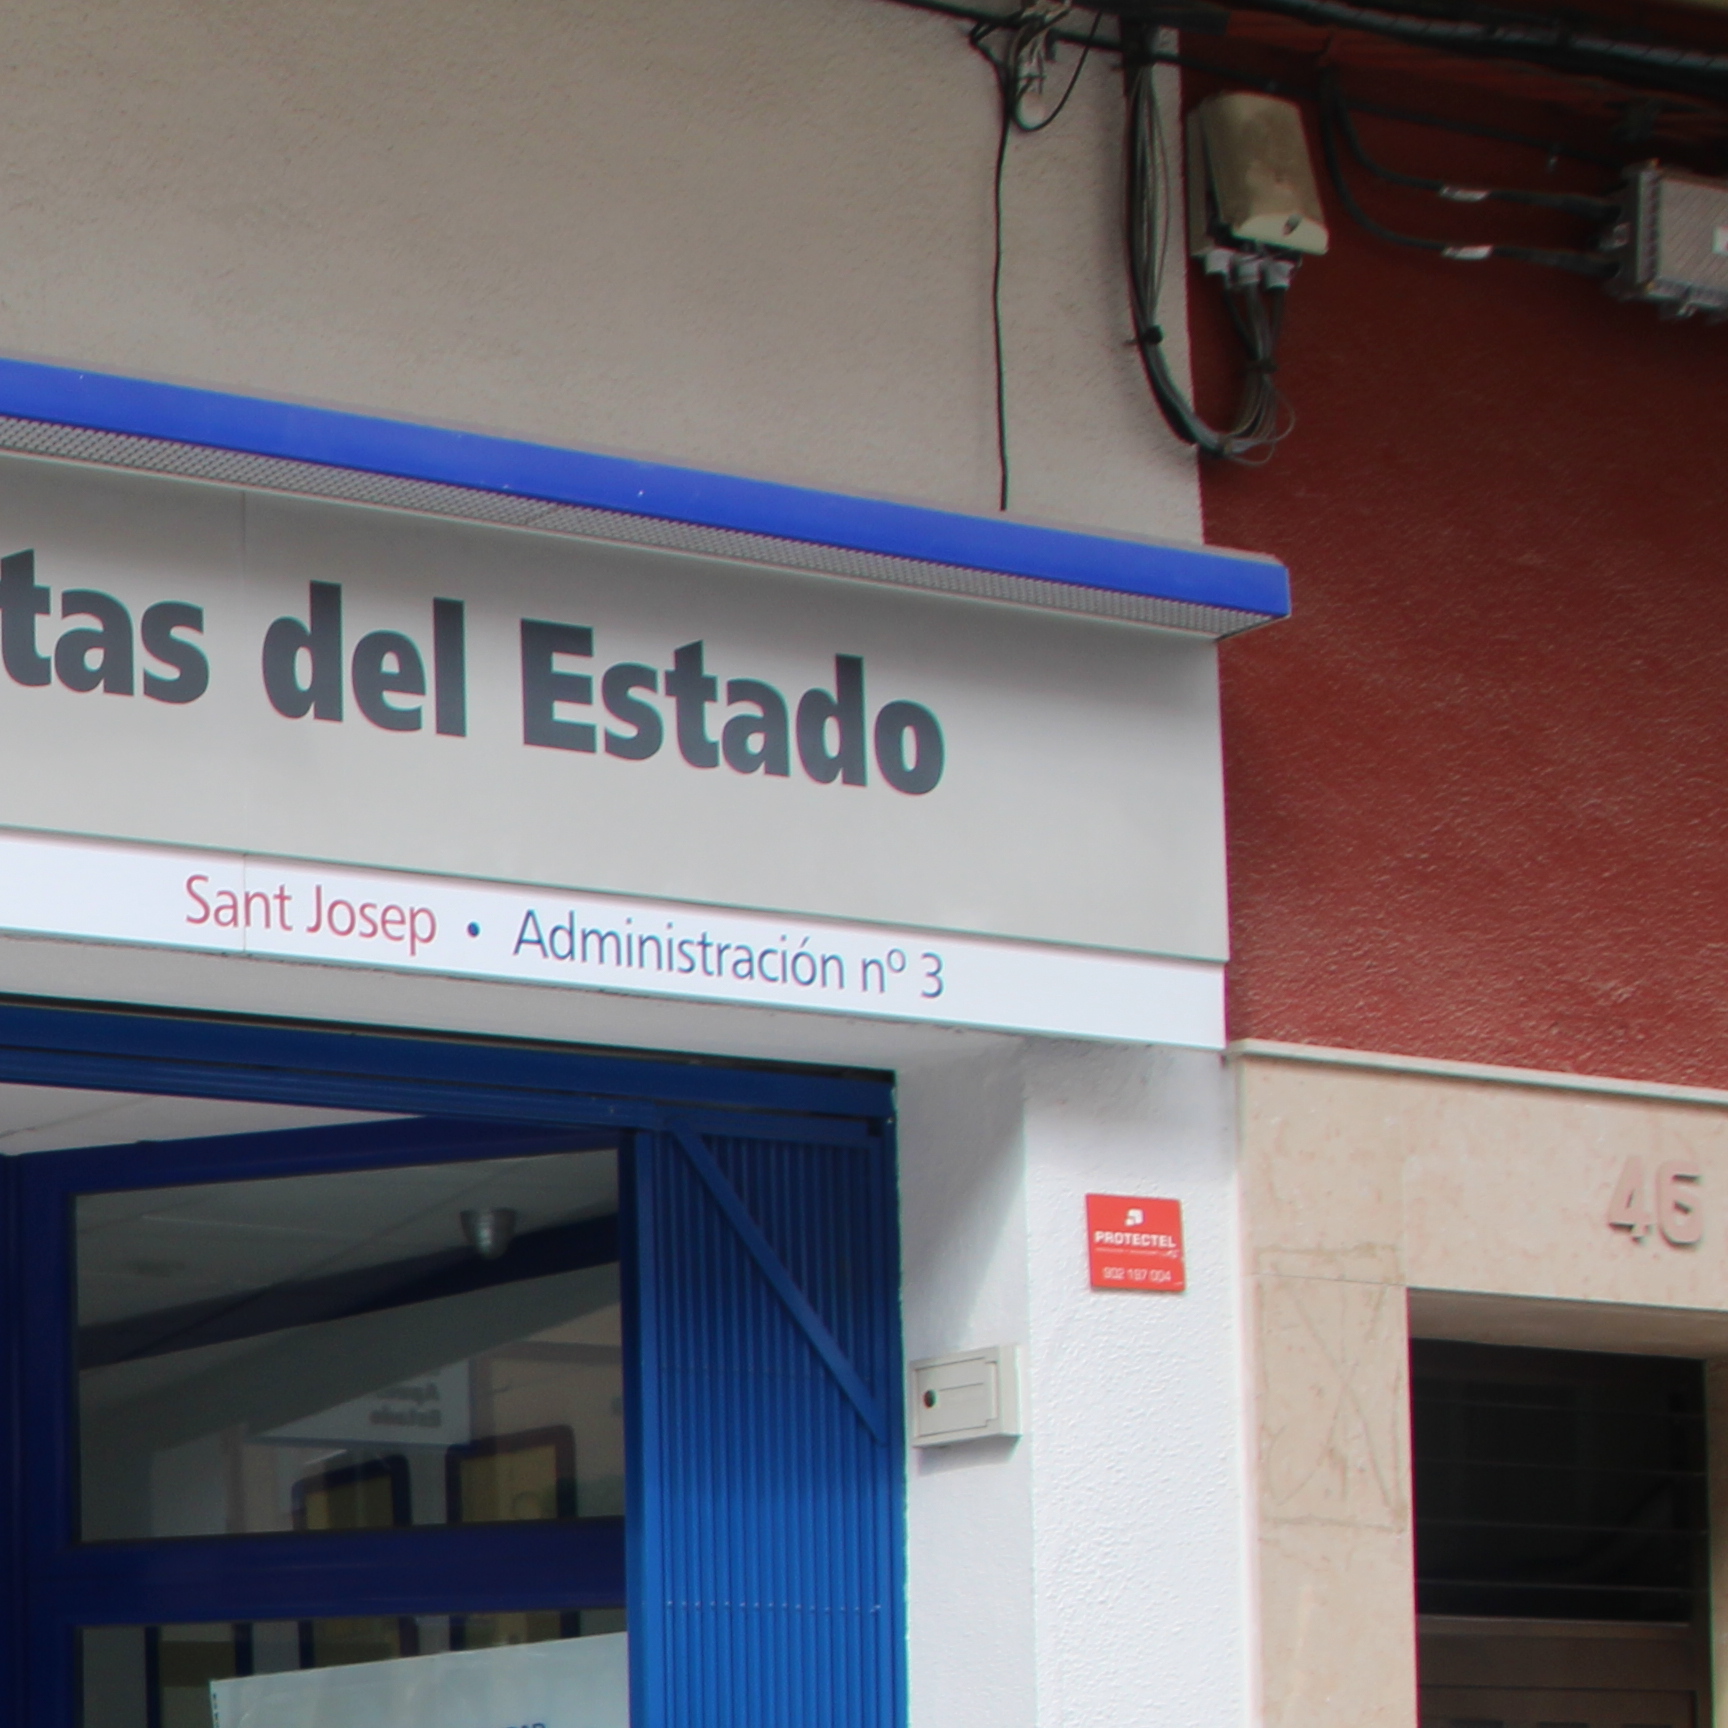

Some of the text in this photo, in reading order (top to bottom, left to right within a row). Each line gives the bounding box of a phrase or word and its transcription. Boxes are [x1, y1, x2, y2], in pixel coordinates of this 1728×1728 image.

[261, 580, 468, 739] del
[520, 617, 945, 797] Estado
[184, 872, 293, 934] Sant
[306, 884, 439, 957] Josep
[513, 907, 846, 991] Administración
[920, 952, 945, 999] 3
[1094, 1230, 1176, 1248] PROTECTEL
